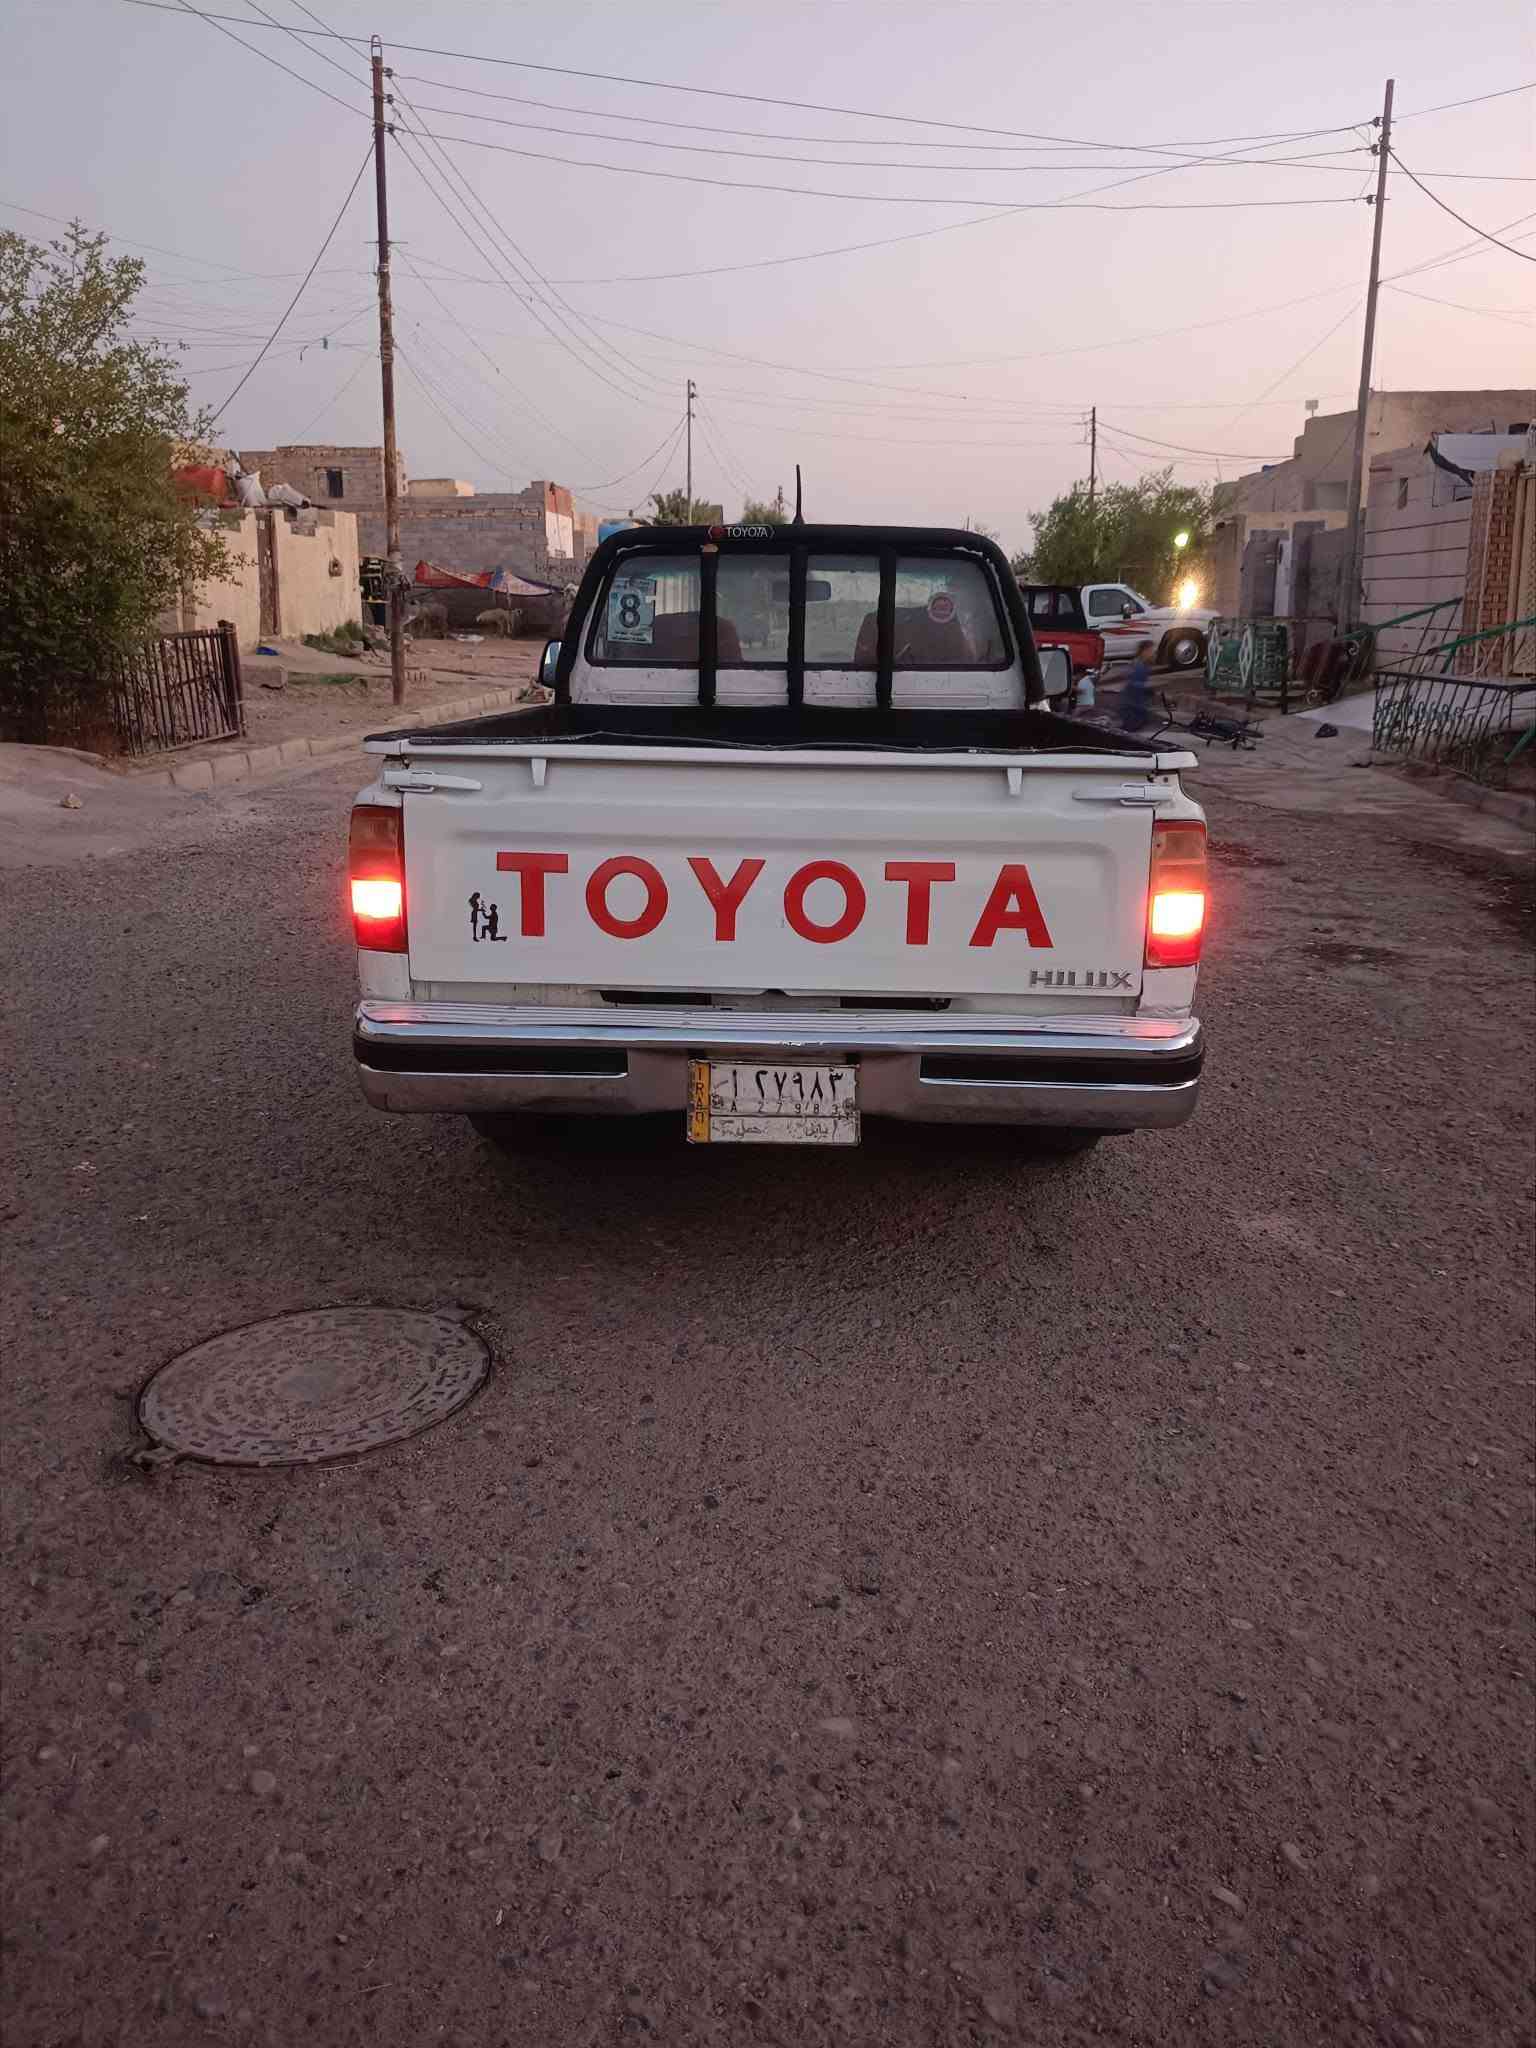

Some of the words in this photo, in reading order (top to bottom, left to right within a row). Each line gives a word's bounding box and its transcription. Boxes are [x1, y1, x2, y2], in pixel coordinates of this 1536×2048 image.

[727, 526, 769, 538] TOYOTA
[619, 594, 641, 628] 8
[496, 851, 1055, 948] TOYOTA
[1030, 970, 1133, 989] HILUX
